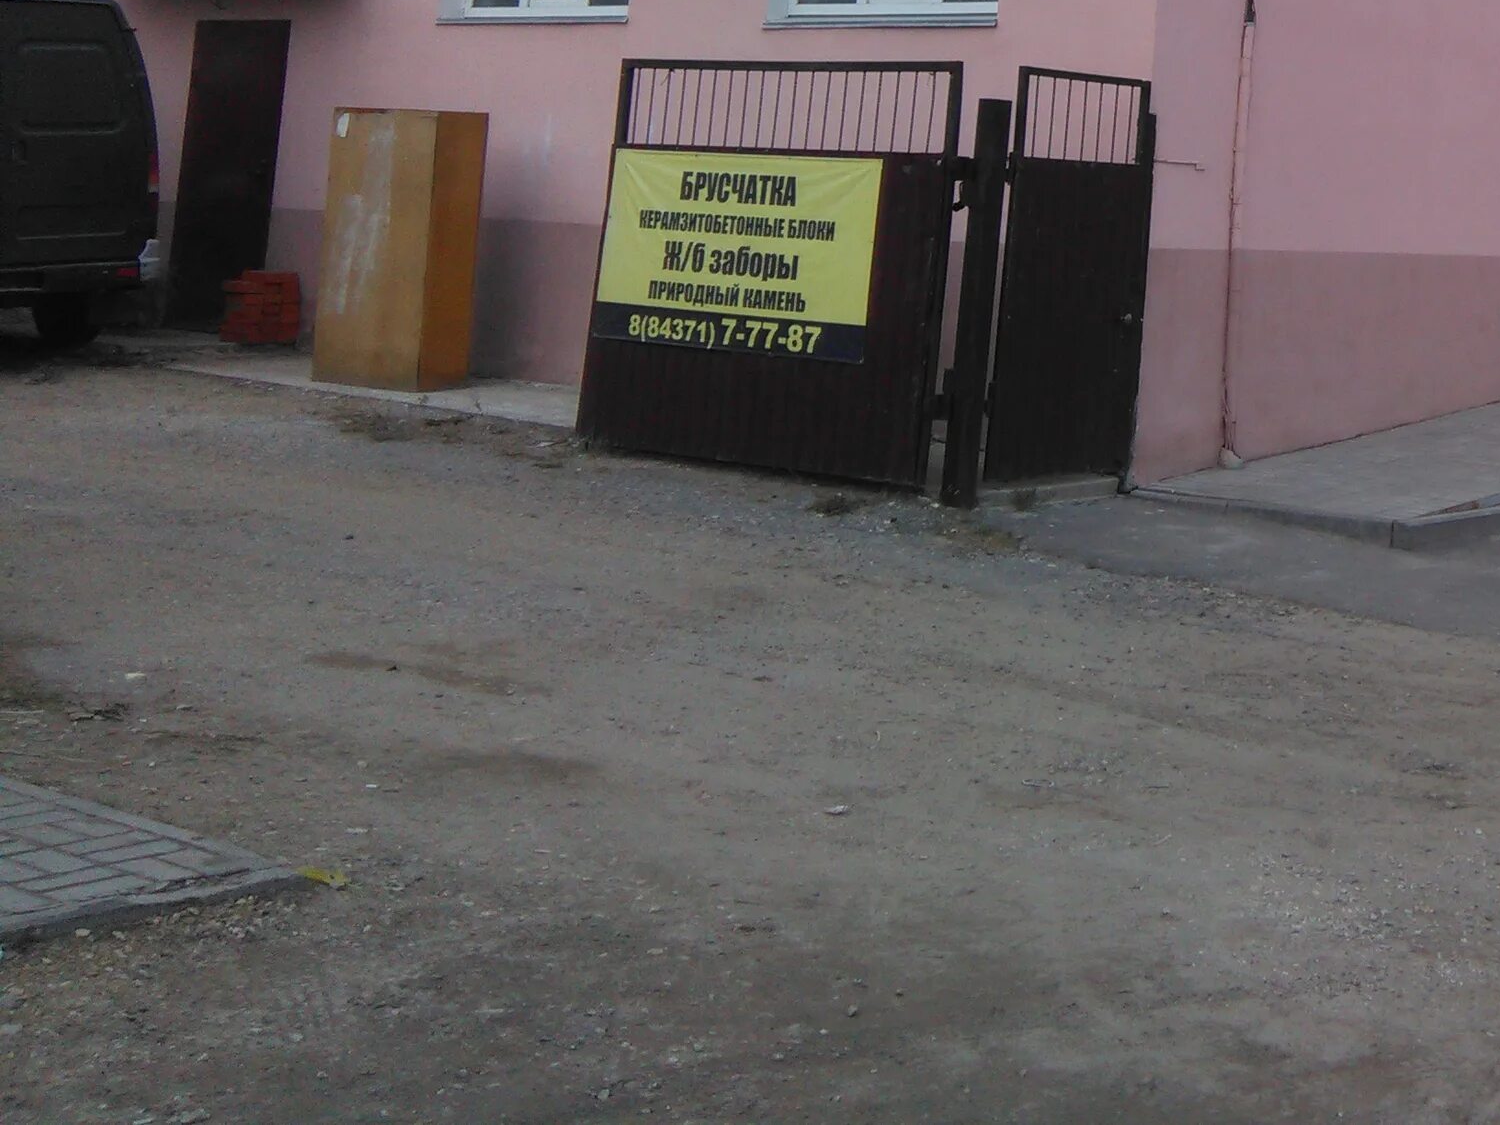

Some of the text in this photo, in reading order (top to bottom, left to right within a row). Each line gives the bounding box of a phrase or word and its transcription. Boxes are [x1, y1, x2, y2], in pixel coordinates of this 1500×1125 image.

[680, 171, 796, 207] БРУСЧАТКА
[639, 209, 835, 241] КЕРАМЗИТОБЕТОННЫЕ БЛОКИ
[709, 246, 799, 280] заборы
[648, 280, 807, 313] ПРИРОДНЫЙ КАМЕНЬ
[628, 314, 822, 354] 8(84371) 7-77-87
